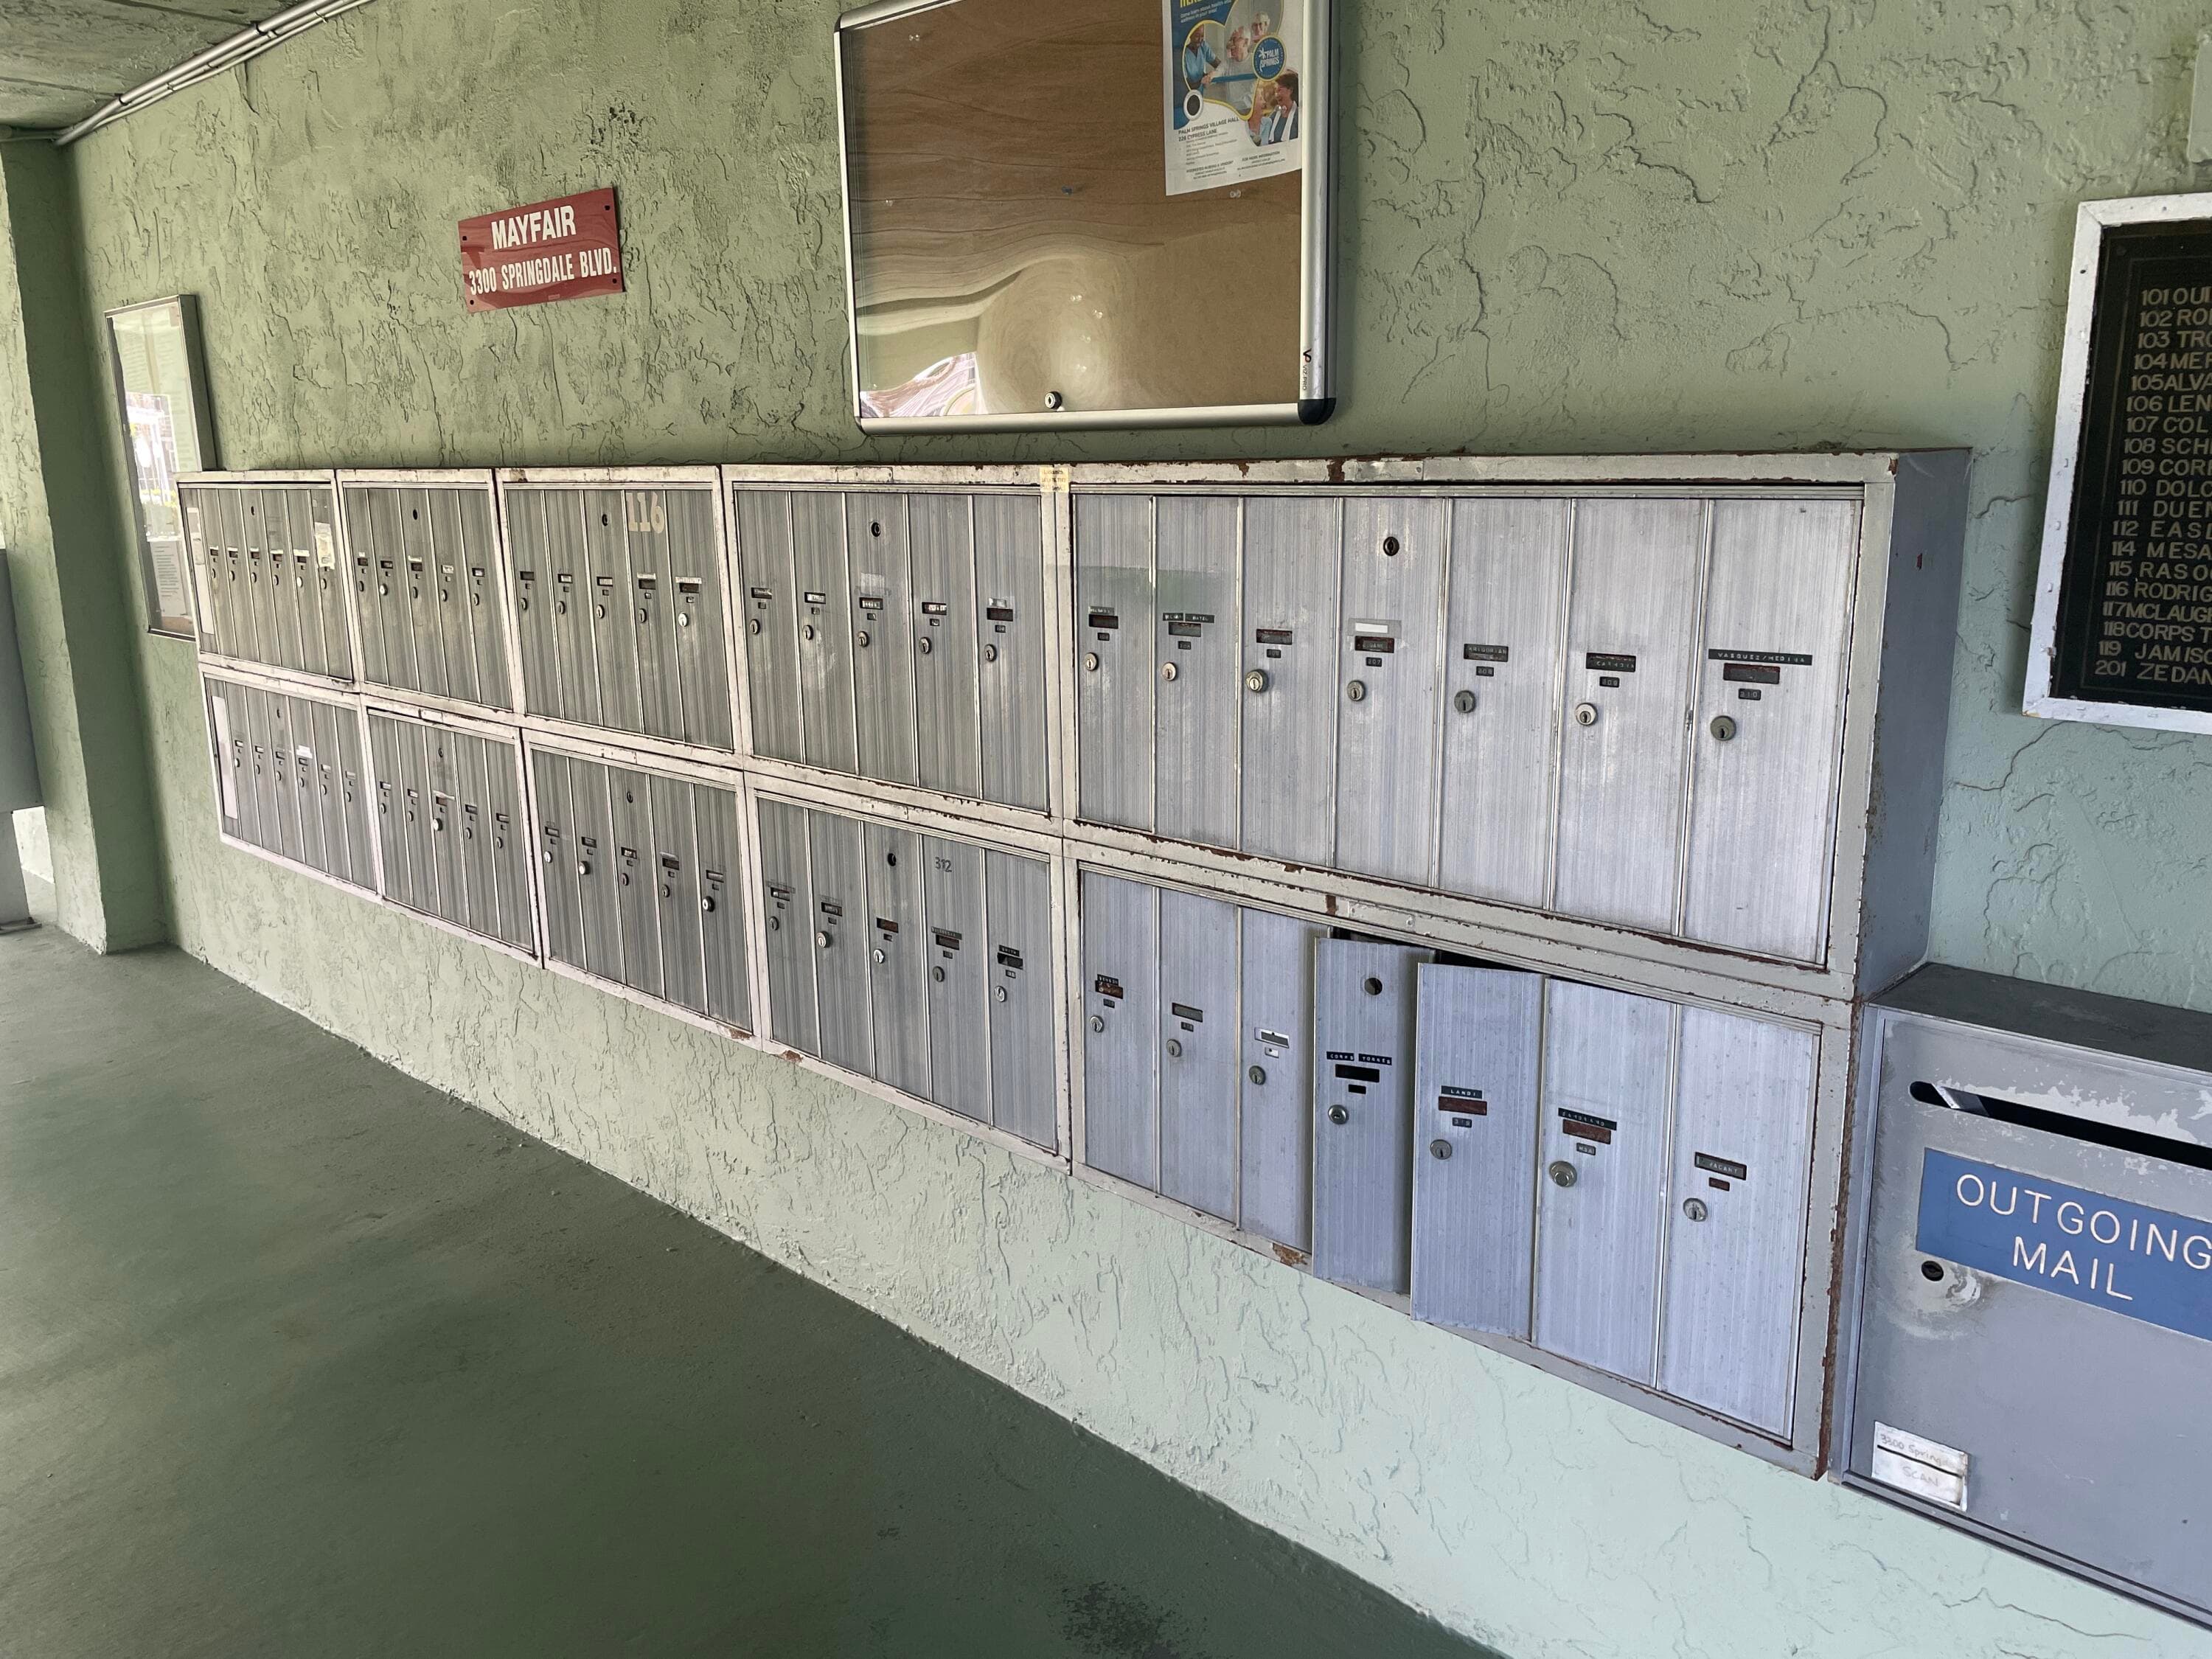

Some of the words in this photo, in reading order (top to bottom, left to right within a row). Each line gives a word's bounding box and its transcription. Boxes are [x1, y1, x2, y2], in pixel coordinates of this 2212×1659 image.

[1191, 123, 1209, 132] SPRINGS
[1210, 119, 1227, 128] VILLAGE
[491, 205, 577, 250] MAYFAIR
[468, 266, 497, 296] 3300
[501, 253, 575, 291] SPRINGDALE
[579, 247, 618, 279] BLVD.
[2141, 288, 2170, 306] 101
[2140, 310, 2173, 327] 102
[2177, 307, 2212, 326] RO
[2138, 330, 2171, 349] 103
[2134, 352, 2168, 370] 104
[2131, 374, 2164, 391] 105
[2126, 394, 2164, 412] 106
[2126, 416, 2159, 434] 107
[2163, 416, 2209, 434] COL
[2124, 437, 2156, 454] 108
[2160, 437, 2212, 455] SCH
[2121, 458, 2155, 476] 109
[2120, 479, 2147, 496] 110
[626, 491, 665, 534] 116
[2118, 499, 2140, 516] 111
[2112, 520, 2139, 537] 112
[2111, 540, 2137, 557] 114
[2109, 560, 2133, 577] 115
[2139, 561, 2212, 582] RASO
[2105, 580, 2129, 597] 116
[2134, 582, 2212, 603] RODRIG
[2102, 601, 2126, 616] 117
[2104, 621, 2125, 636] 118
[2126, 622, 2196, 642] CORPS
[2098, 640, 2122, 656] 119
[2094, 660, 2127, 677] 201
[2136, 661, 2212, 686] ZEDAN
[935, 857, 952, 872] 312
[1956, 1173, 2212, 1270] OUTGOING
[2013, 1236, 2134, 1301] MAIL
[1880, 1433, 1905, 1450] 3300
